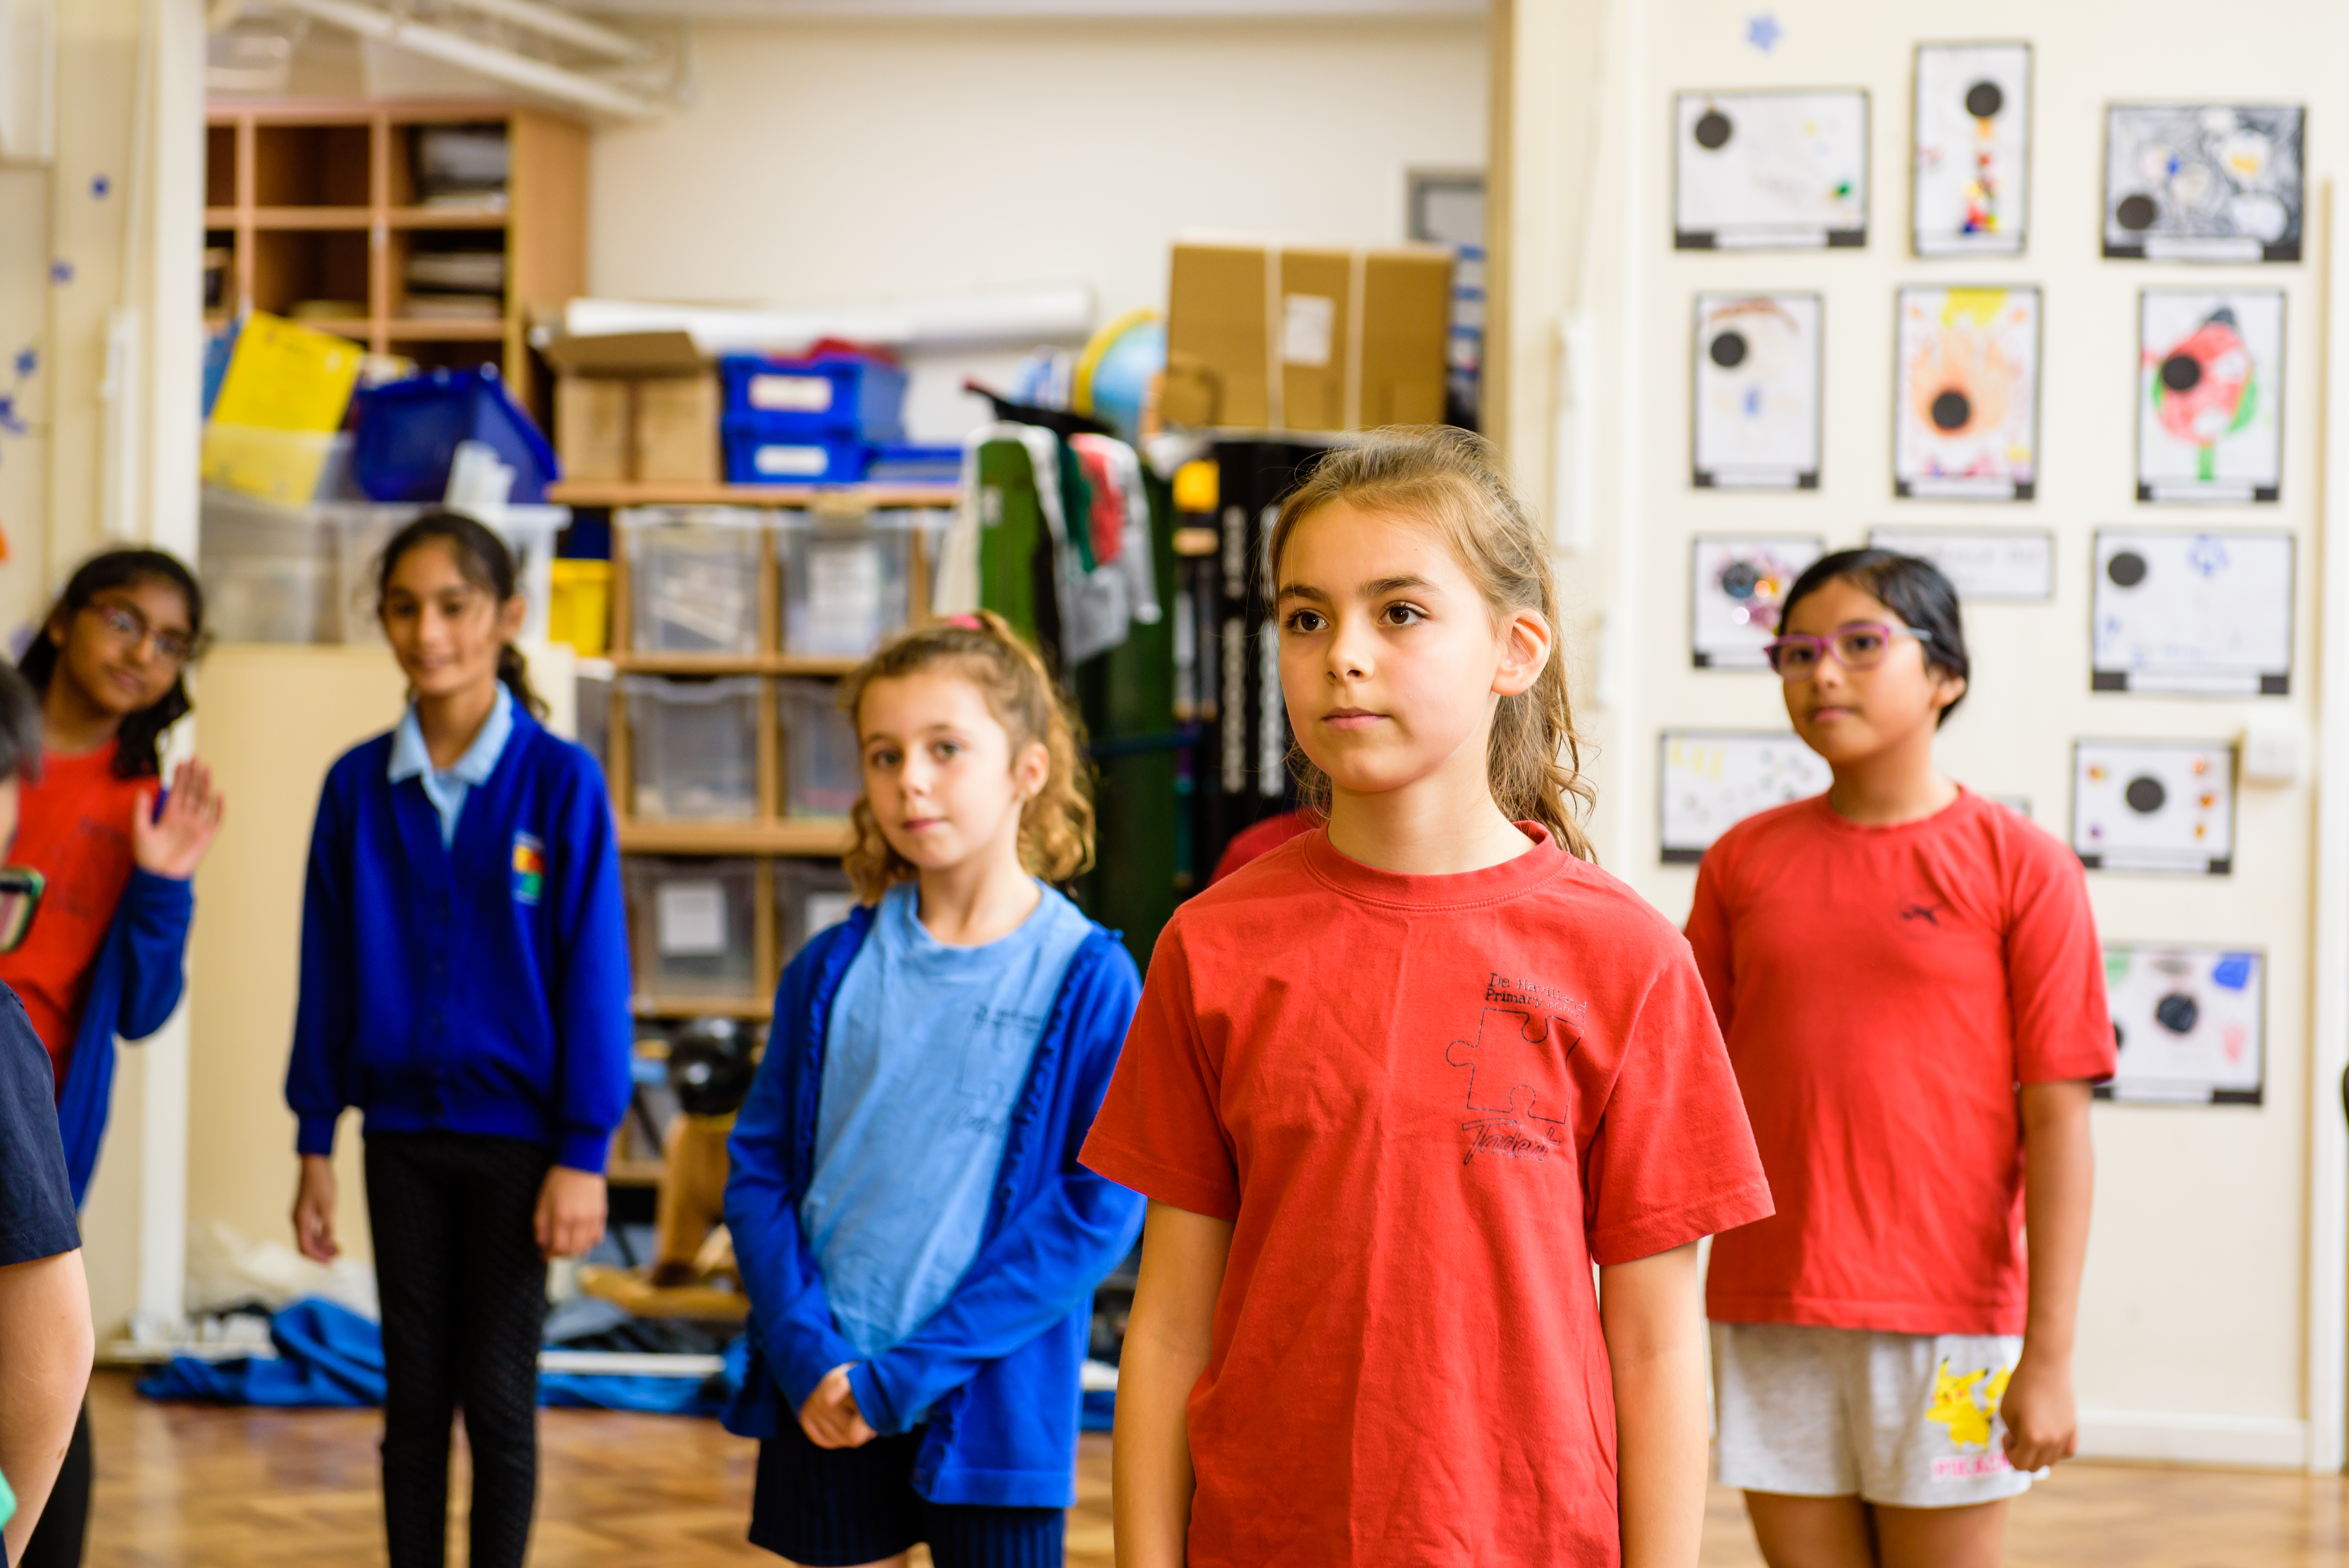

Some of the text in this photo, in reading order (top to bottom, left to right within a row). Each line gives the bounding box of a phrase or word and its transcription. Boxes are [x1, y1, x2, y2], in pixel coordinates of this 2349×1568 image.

[1485, 988, 1585, 1024] Primary School
[1488, 973, 1587, 1013] De Havilland
